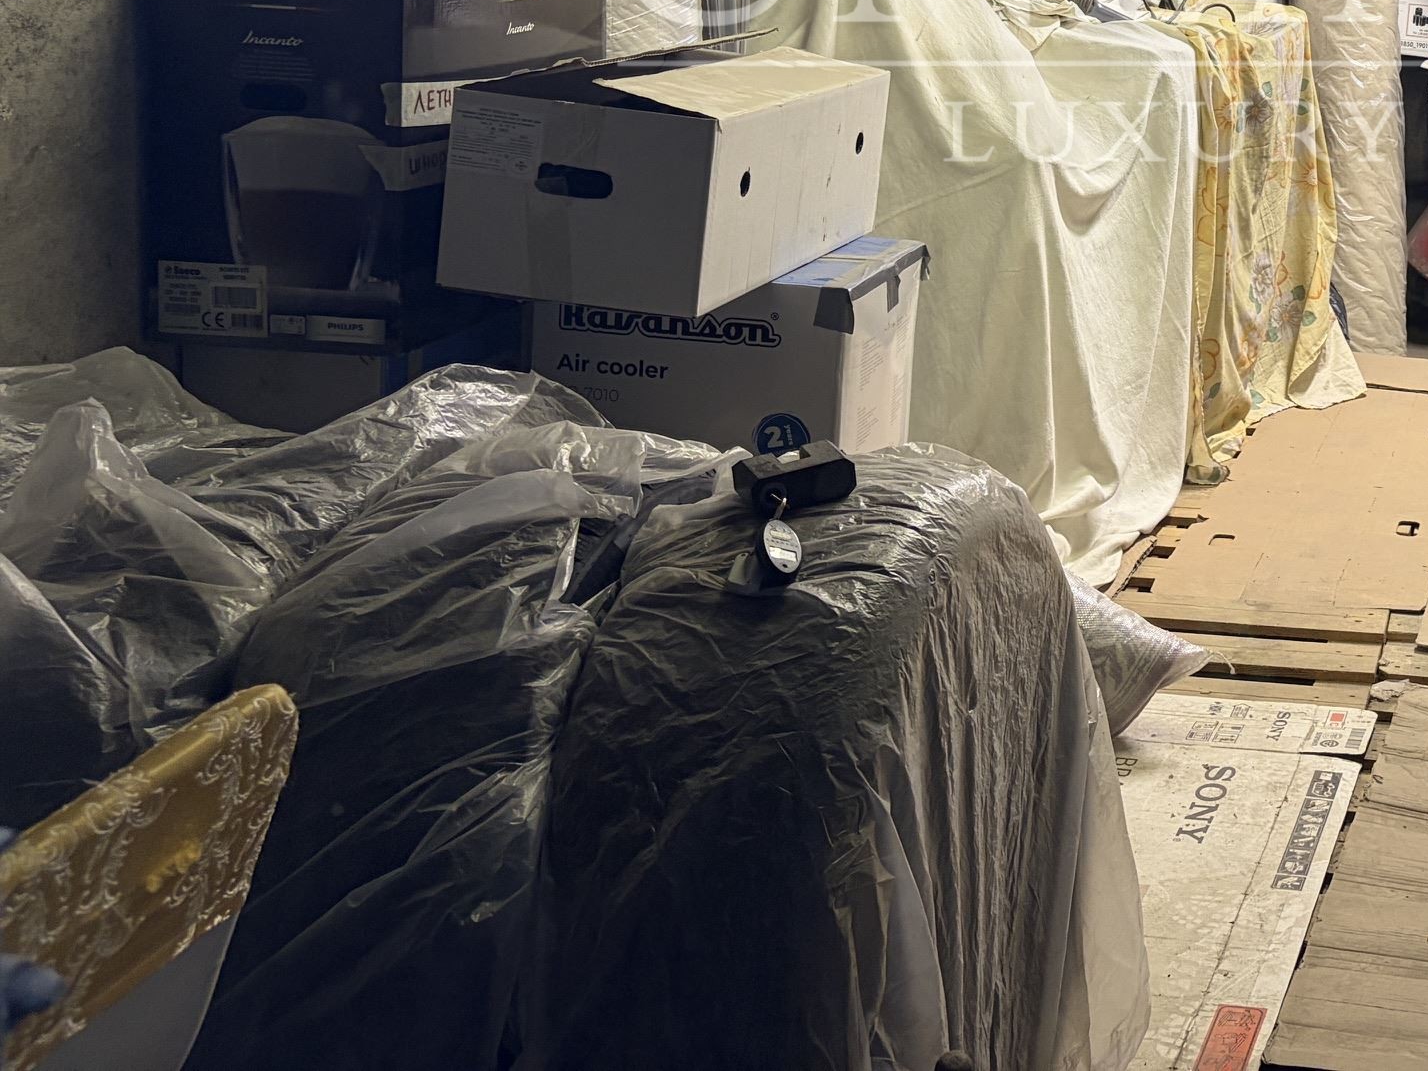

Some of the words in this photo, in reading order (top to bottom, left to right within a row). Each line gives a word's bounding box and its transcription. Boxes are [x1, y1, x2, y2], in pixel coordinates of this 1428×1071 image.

[241, 30, 304, 47] Incanto
[506, 21, 535, 36] Incanto
[413, 89, 452, 114] ЛЕТН
[327, 321, 365, 331] PHILIPS
[556, 353, 590, 372] Air
[596, 360, 669, 379] cooler
[764, 426, 785, 448] 2
[1266, 711, 1291, 741] SONY
[1176, 765, 1237, 844] SONY
